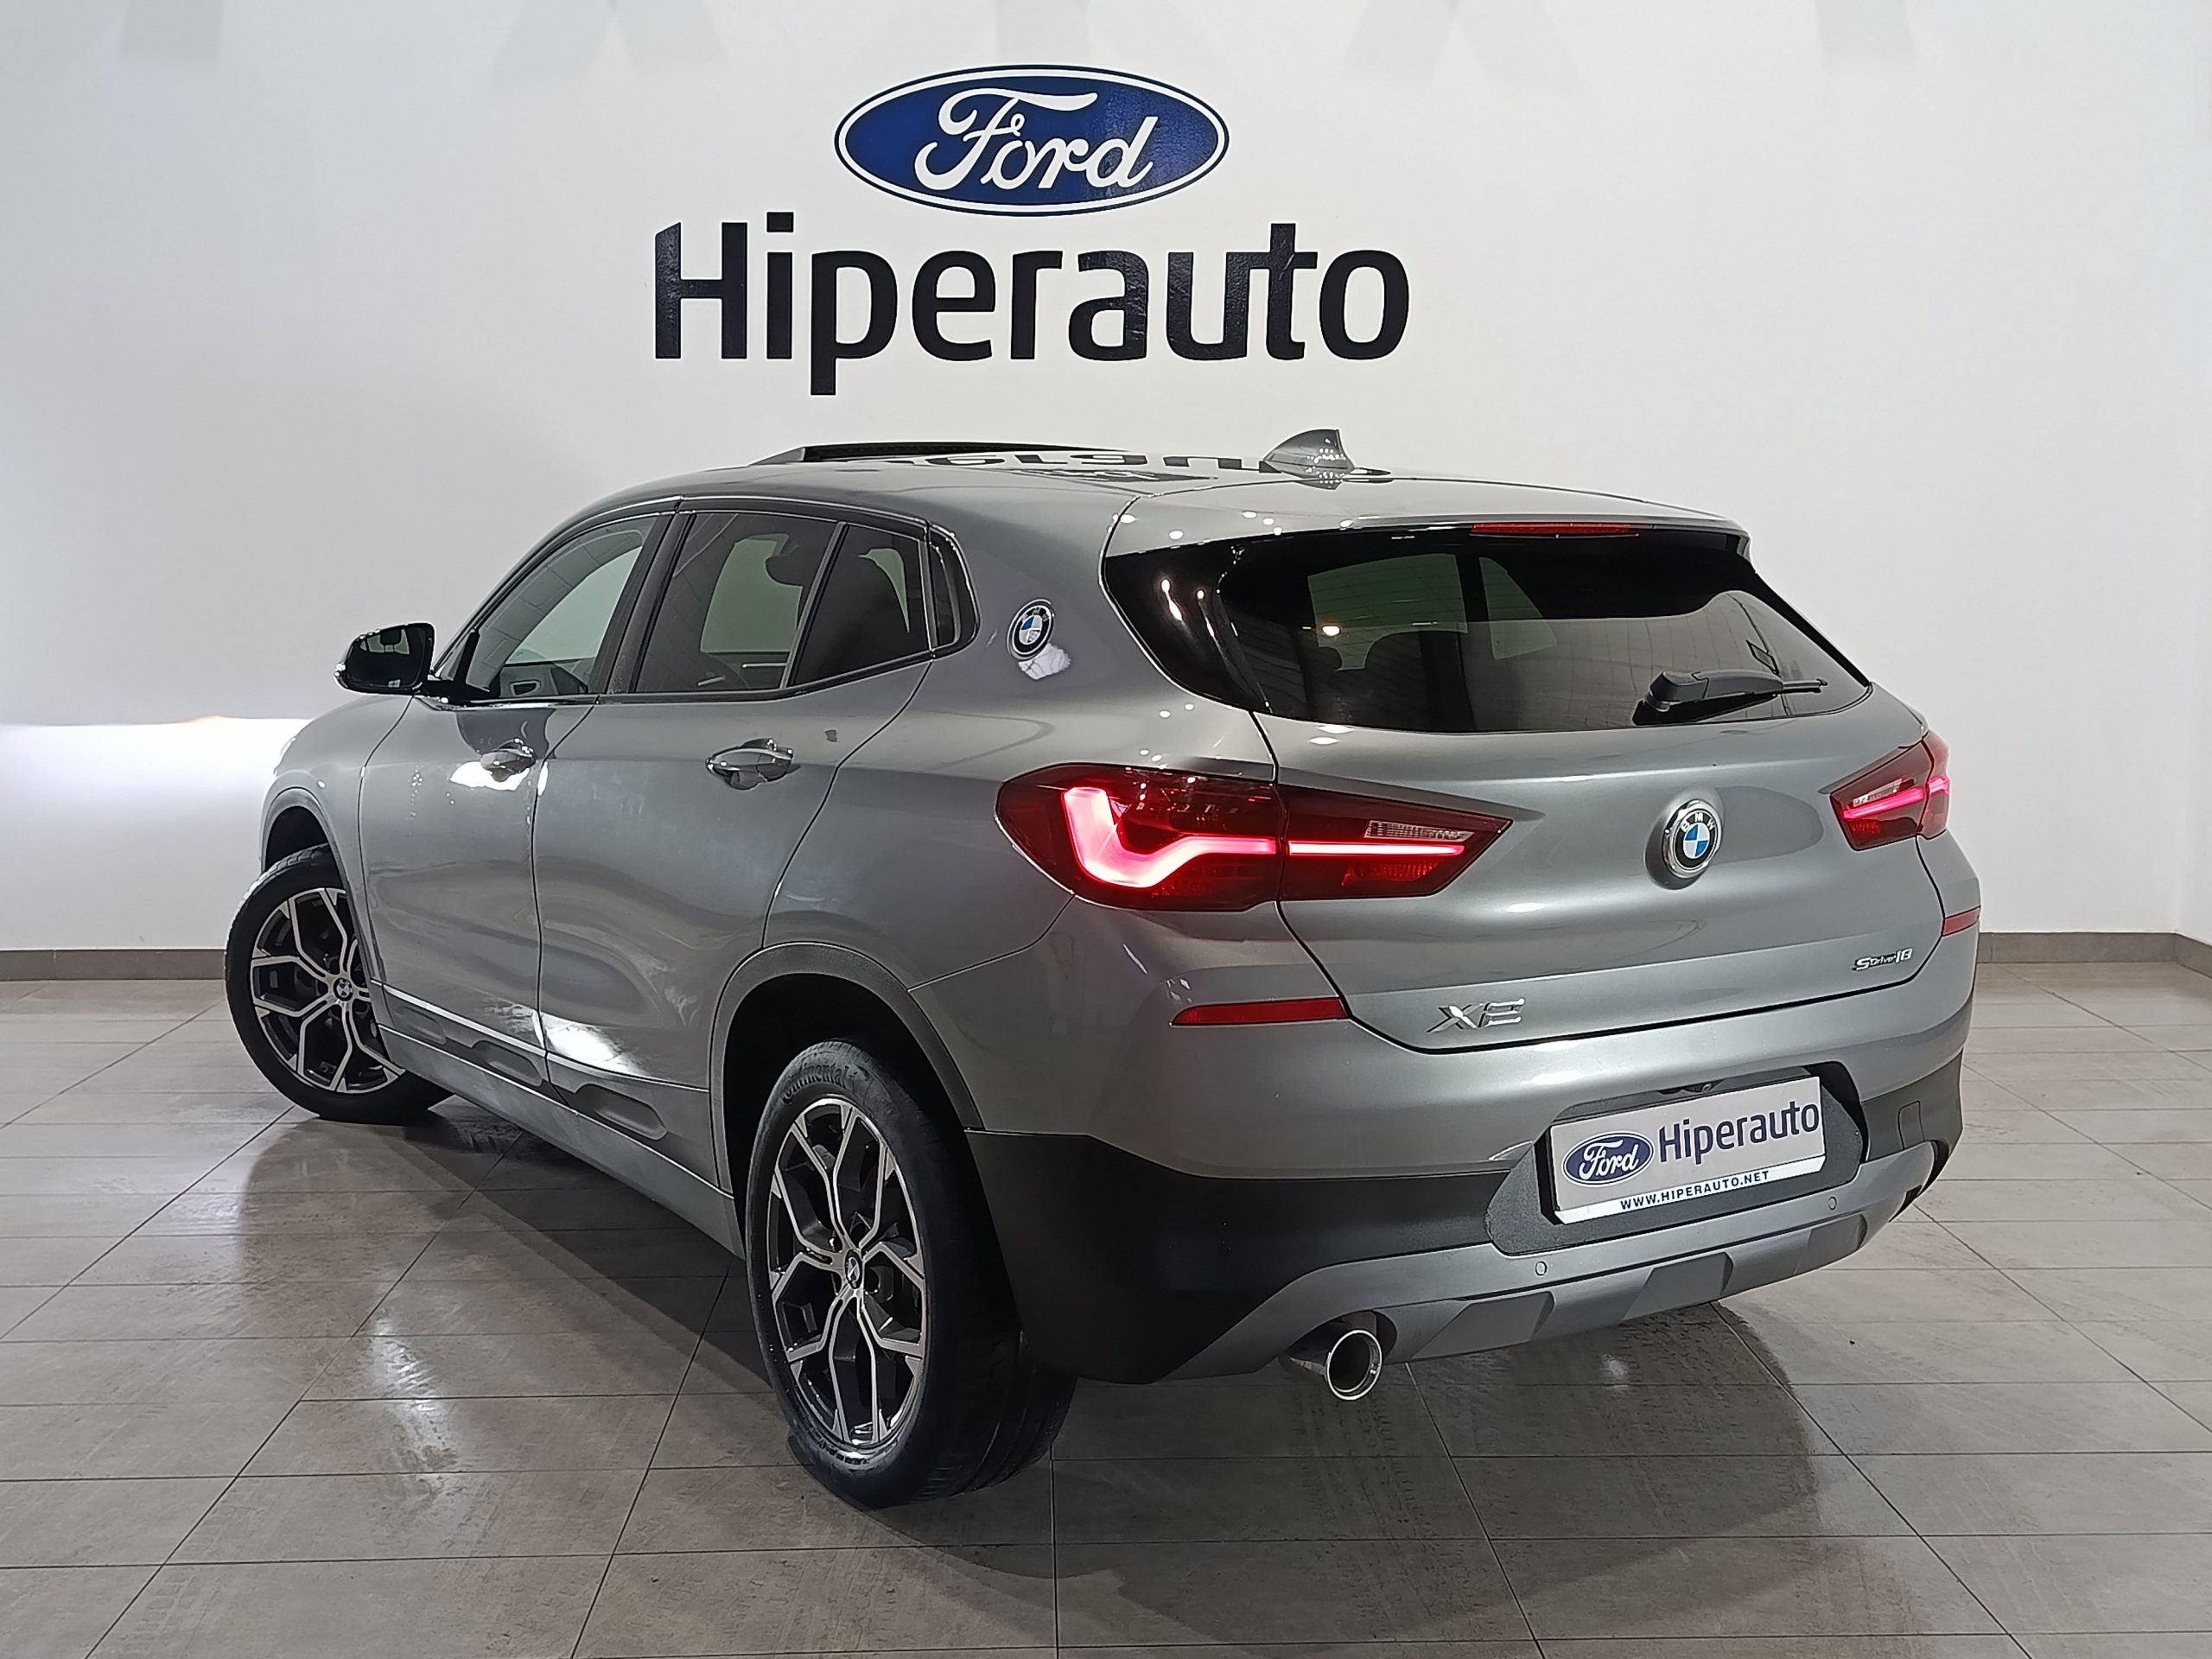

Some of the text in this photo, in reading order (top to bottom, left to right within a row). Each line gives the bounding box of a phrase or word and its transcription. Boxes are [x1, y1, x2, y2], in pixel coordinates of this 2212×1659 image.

[914, 87, 1159, 190] Ford
[654, 211, 1410, 396] Hiperauto
[1681, 812, 1715, 833] BMW
[1578, 1100, 1820, 1180] Ford Hiperauto
[1619, 1169, 1770, 1211] WWW.HIPERAUTO.NET
